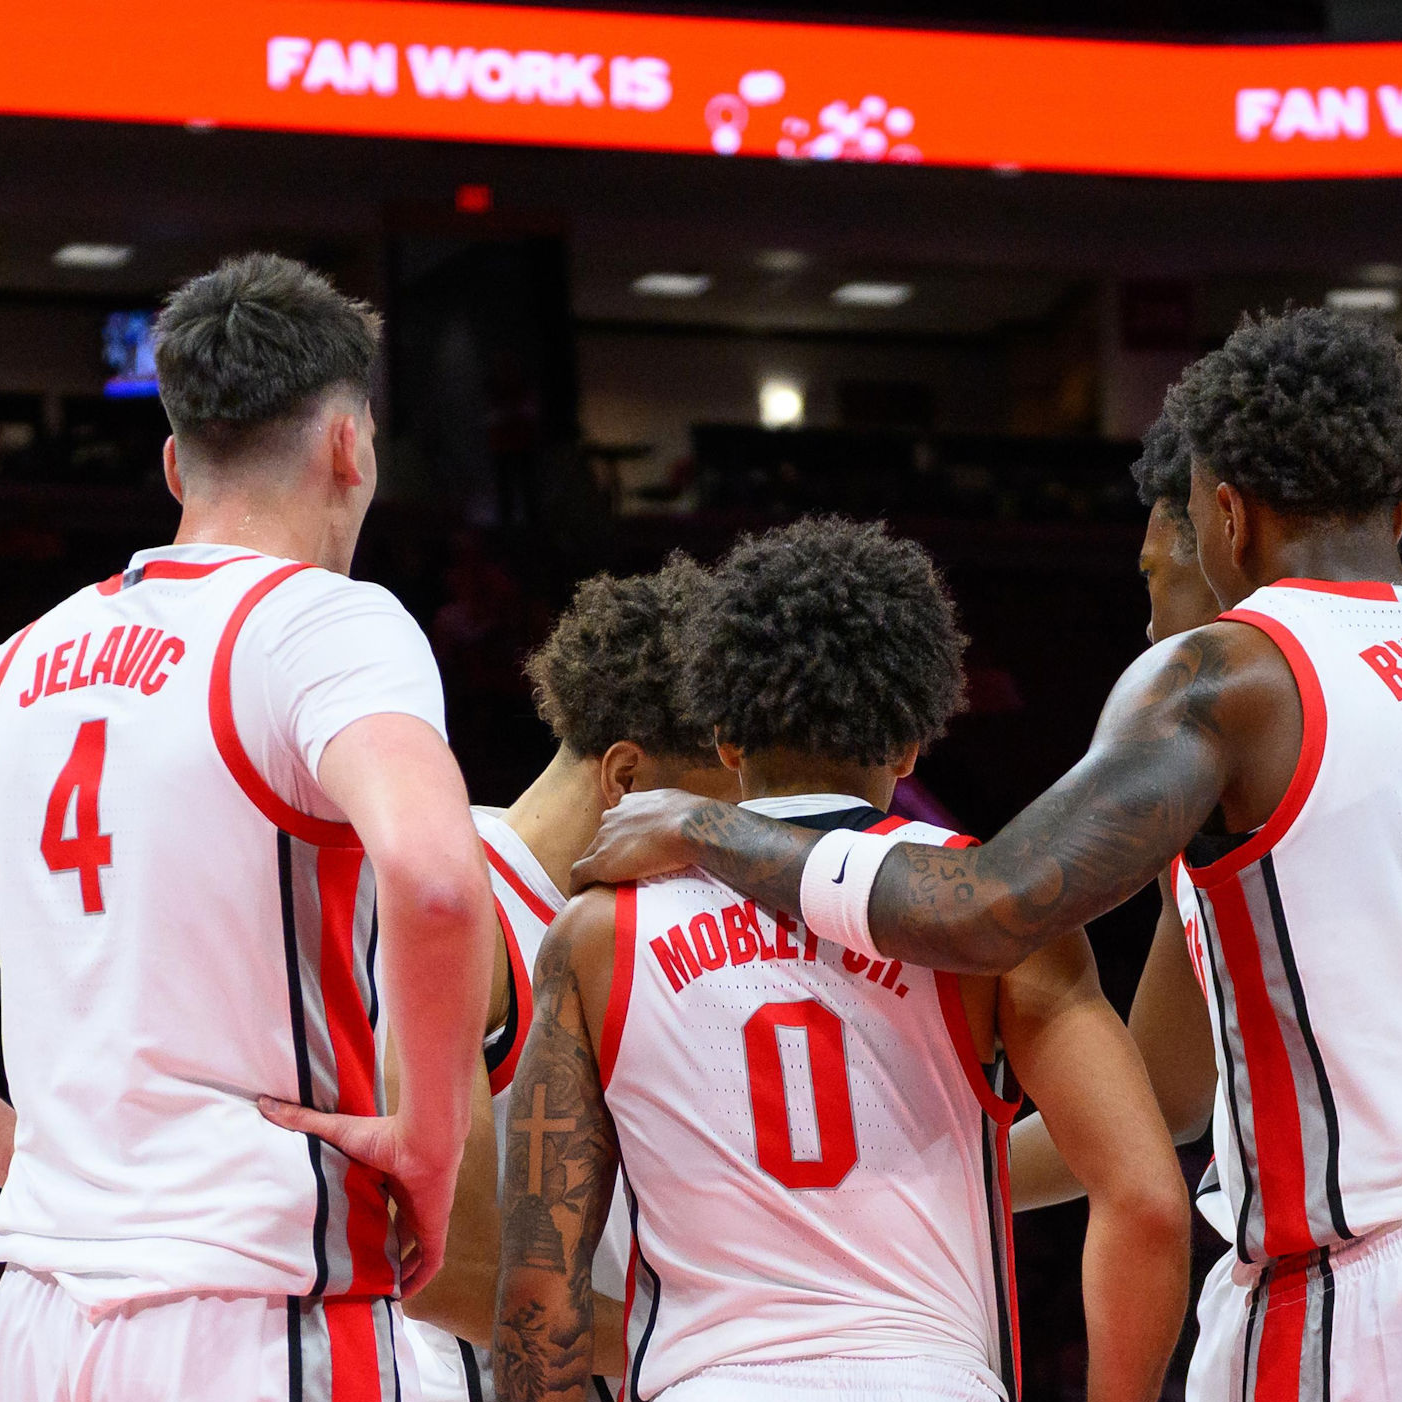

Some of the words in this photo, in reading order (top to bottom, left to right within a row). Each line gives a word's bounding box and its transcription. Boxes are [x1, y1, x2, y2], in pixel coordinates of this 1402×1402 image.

[266, 35, 397, 95] FAN
[406, 43, 604, 107] WORK
[609, 55, 673, 112] IS
[1235, 87, 1369, 142] FAN
[19, 624, 186, 708] JELAVIC
[39, 716, 114, 917] 4
[742, 998, 861, 1191] 0
